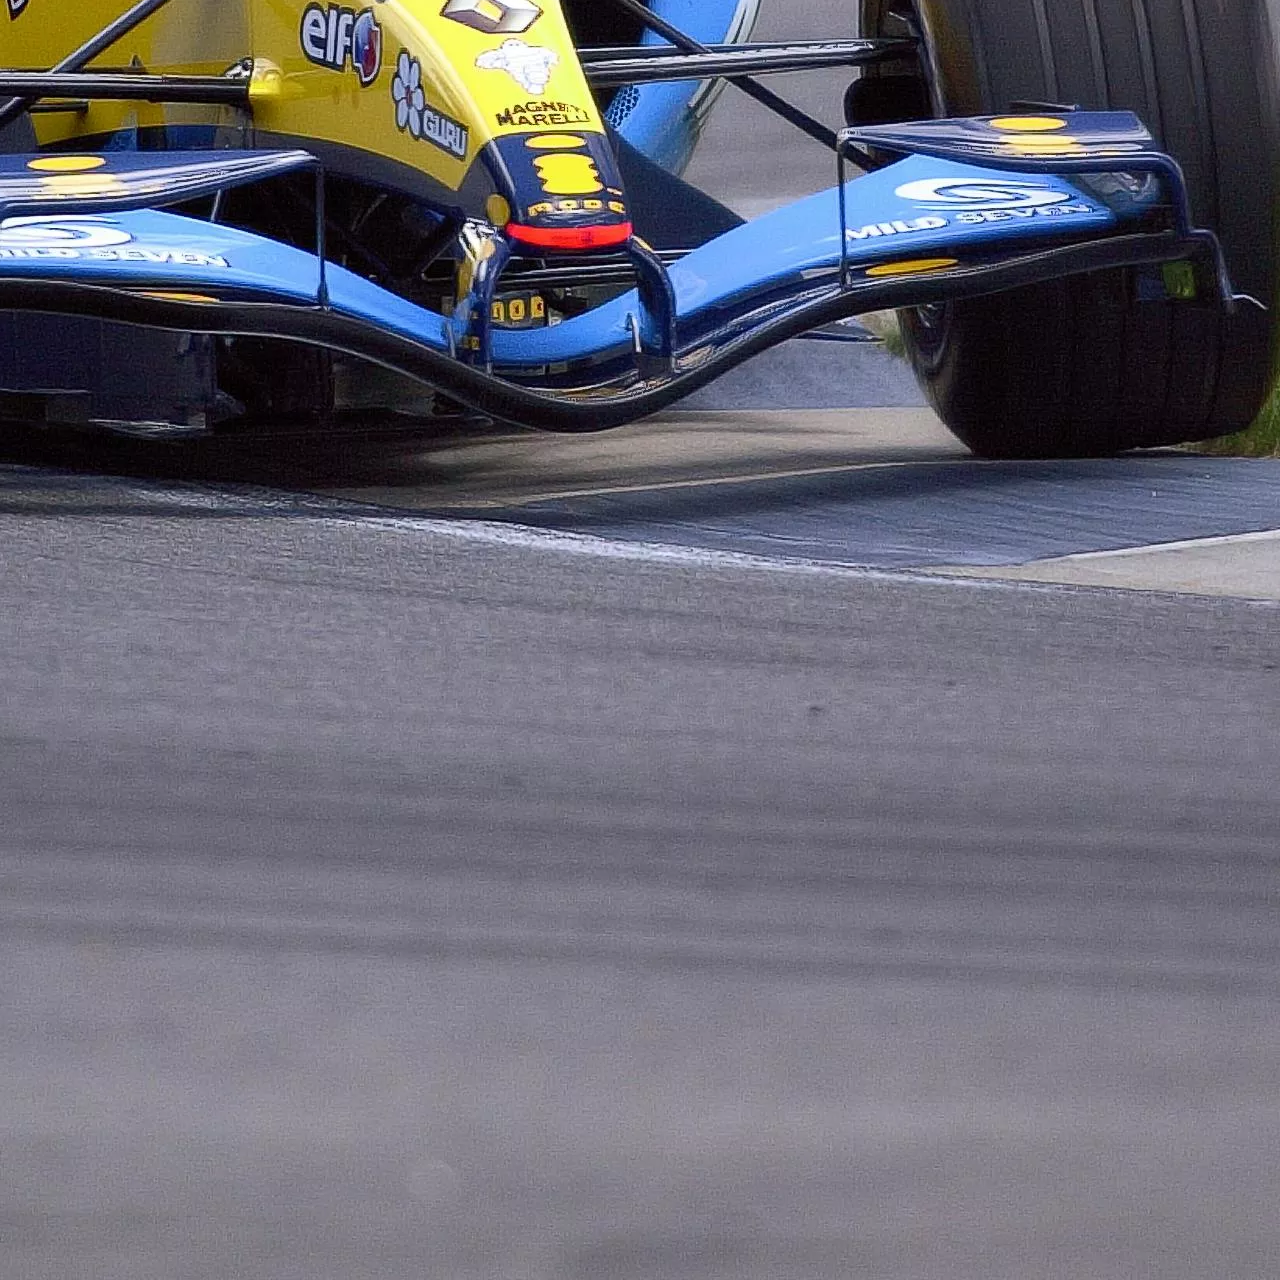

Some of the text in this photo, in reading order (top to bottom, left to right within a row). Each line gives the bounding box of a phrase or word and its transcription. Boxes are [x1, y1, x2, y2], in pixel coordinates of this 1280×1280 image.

[302, 7, 356, 67] elf
[423, 108, 468, 157] GURU
[846, 216, 950, 241] MILD
